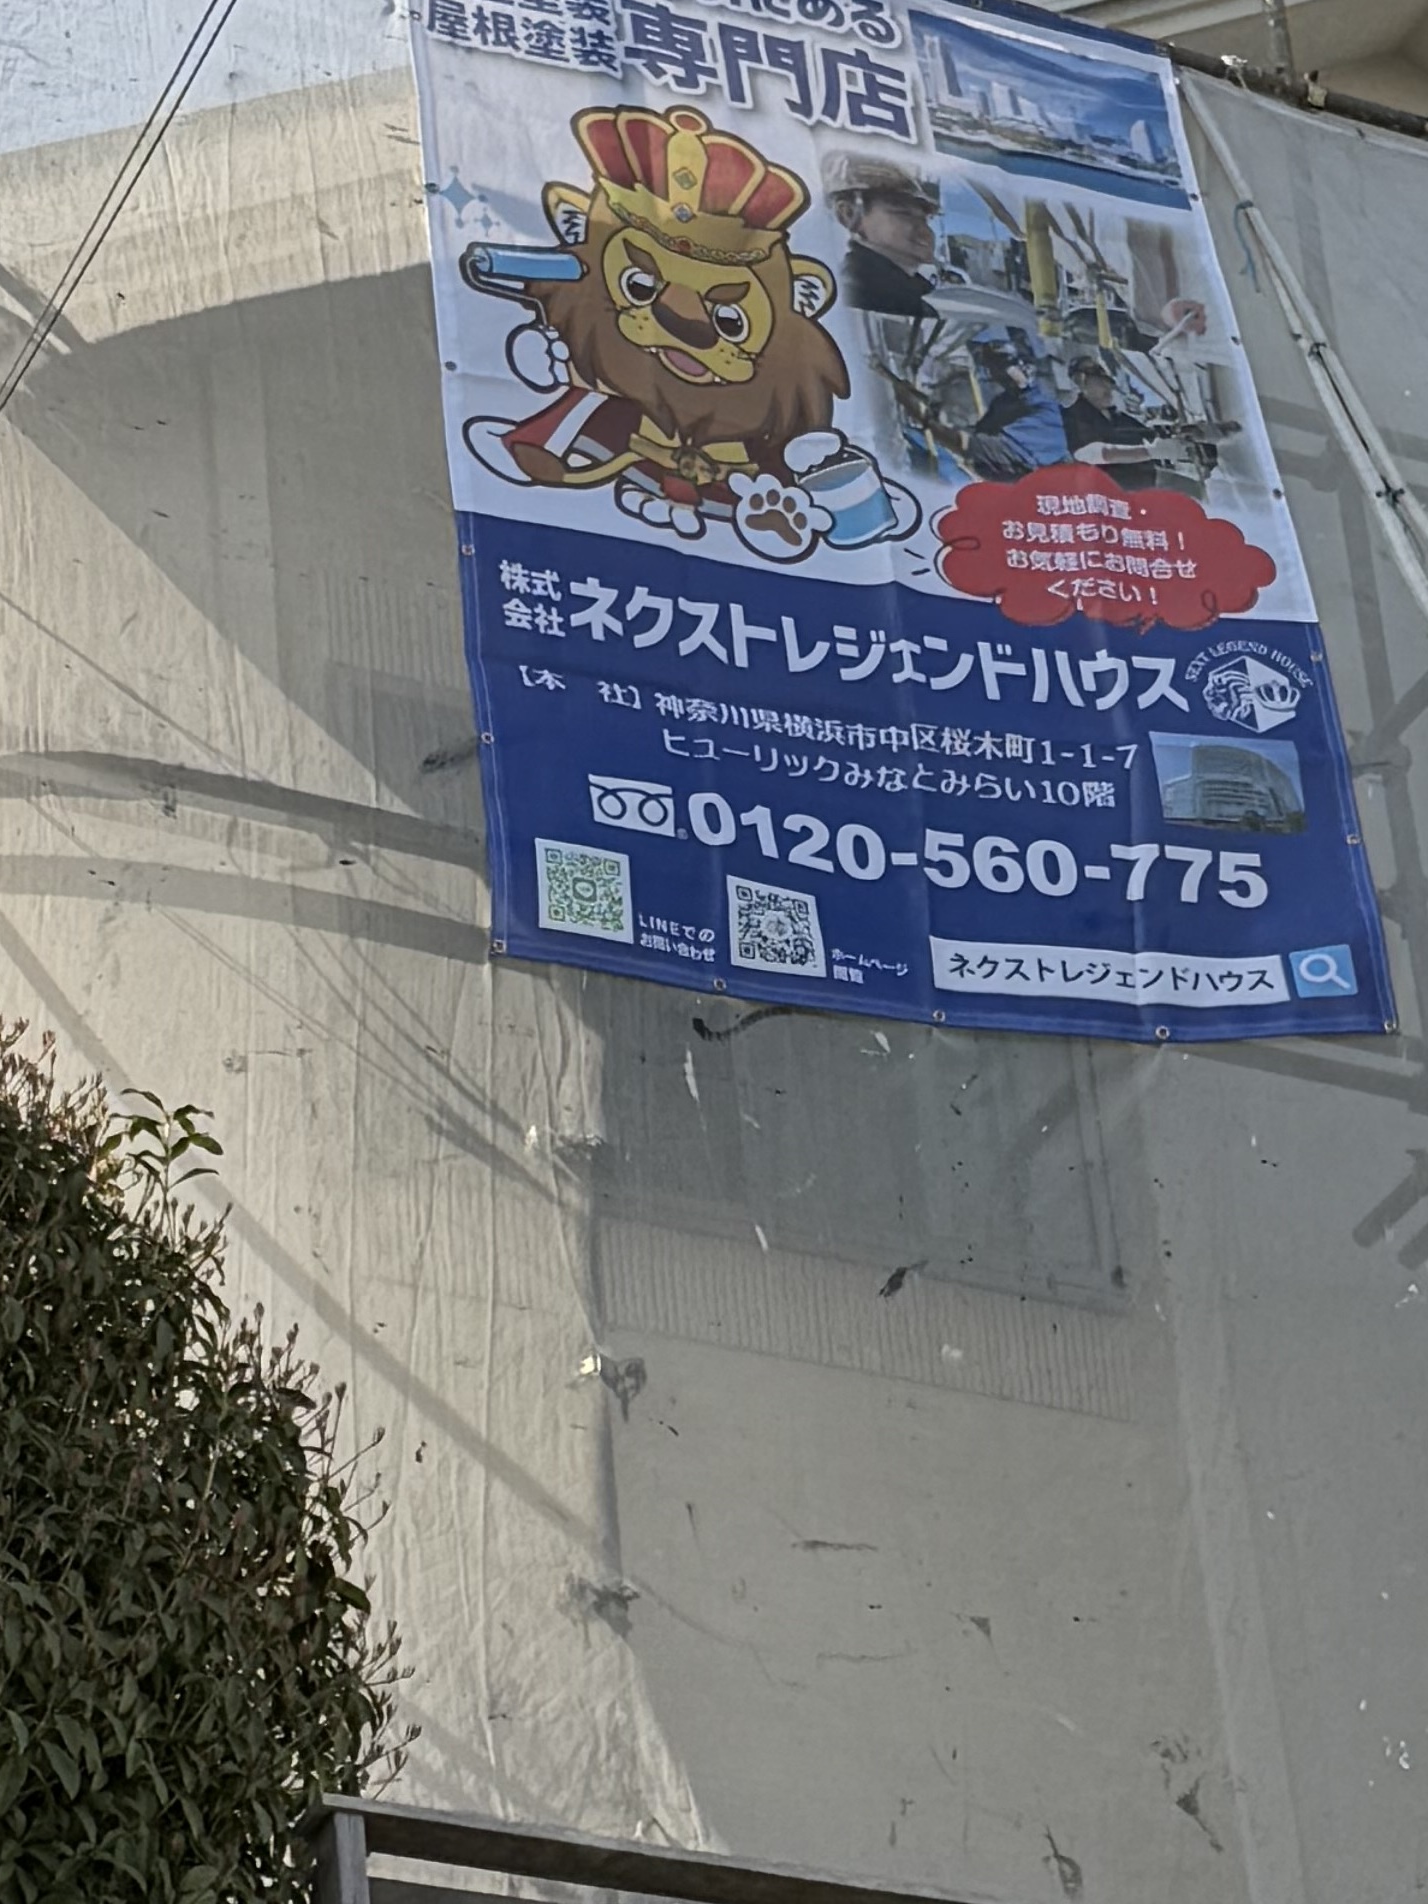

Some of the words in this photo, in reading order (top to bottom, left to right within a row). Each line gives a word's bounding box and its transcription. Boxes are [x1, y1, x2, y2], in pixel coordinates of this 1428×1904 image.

[500, 559, 562, 601] 株式
[1006, 548, 1197, 580] お気軽にお問合せ
[503, 597, 566, 637] 会社
[569, 576, 1190, 713] ネクストレジェンドハウス
[1208, 640, 1268, 658] LEGEND
[1270, 649, 1314, 688] HOUSE
[662, 728, 1116, 807] ヒューリックみなとみらい10階
[687, 791, 1269, 909] 0120-560-775
[638, 914, 716, 943] LINEでの
[948, 952, 1275, 992] ネクストレジェンドハウス
